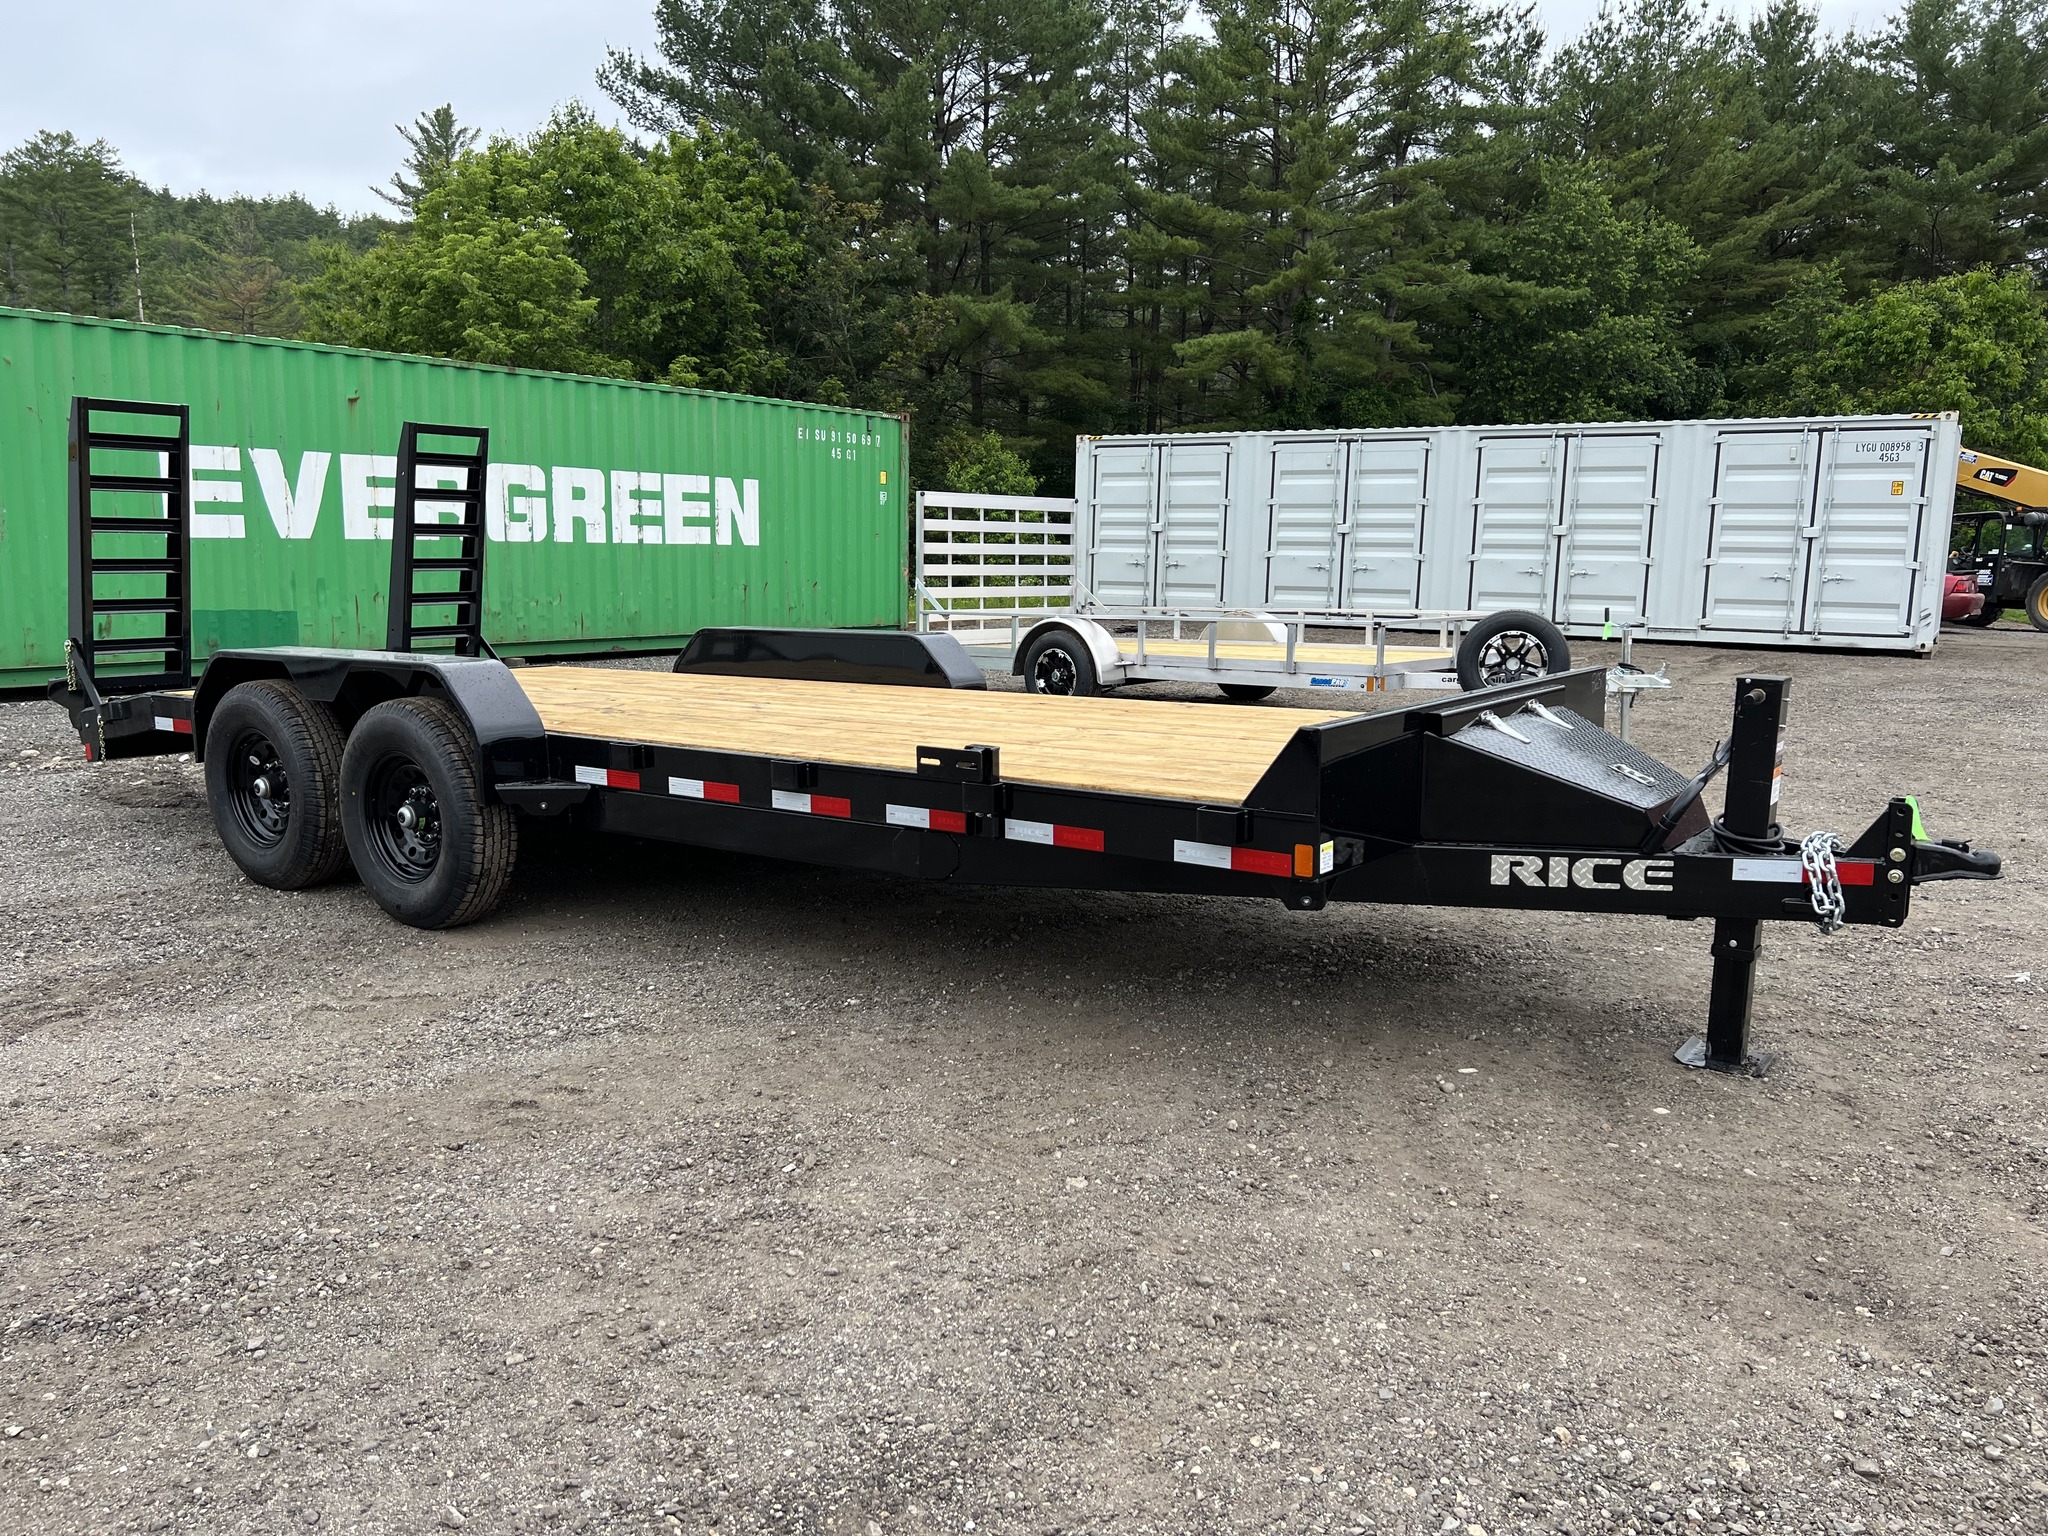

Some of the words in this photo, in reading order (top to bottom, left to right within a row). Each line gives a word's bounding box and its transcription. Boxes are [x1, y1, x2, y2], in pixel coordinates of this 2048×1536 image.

[1855, 442, 1877, 453] LYGU
[1879, 441, 1911, 452] 008958
[1918, 441, 1924, 452] 3
[1879, 452, 1900, 462] 45G3
[1979, 469, 1995, 482] CAT
[158, 444, 760, 546] EVERGREEN
[1490, 854, 1675, 892] RICE
